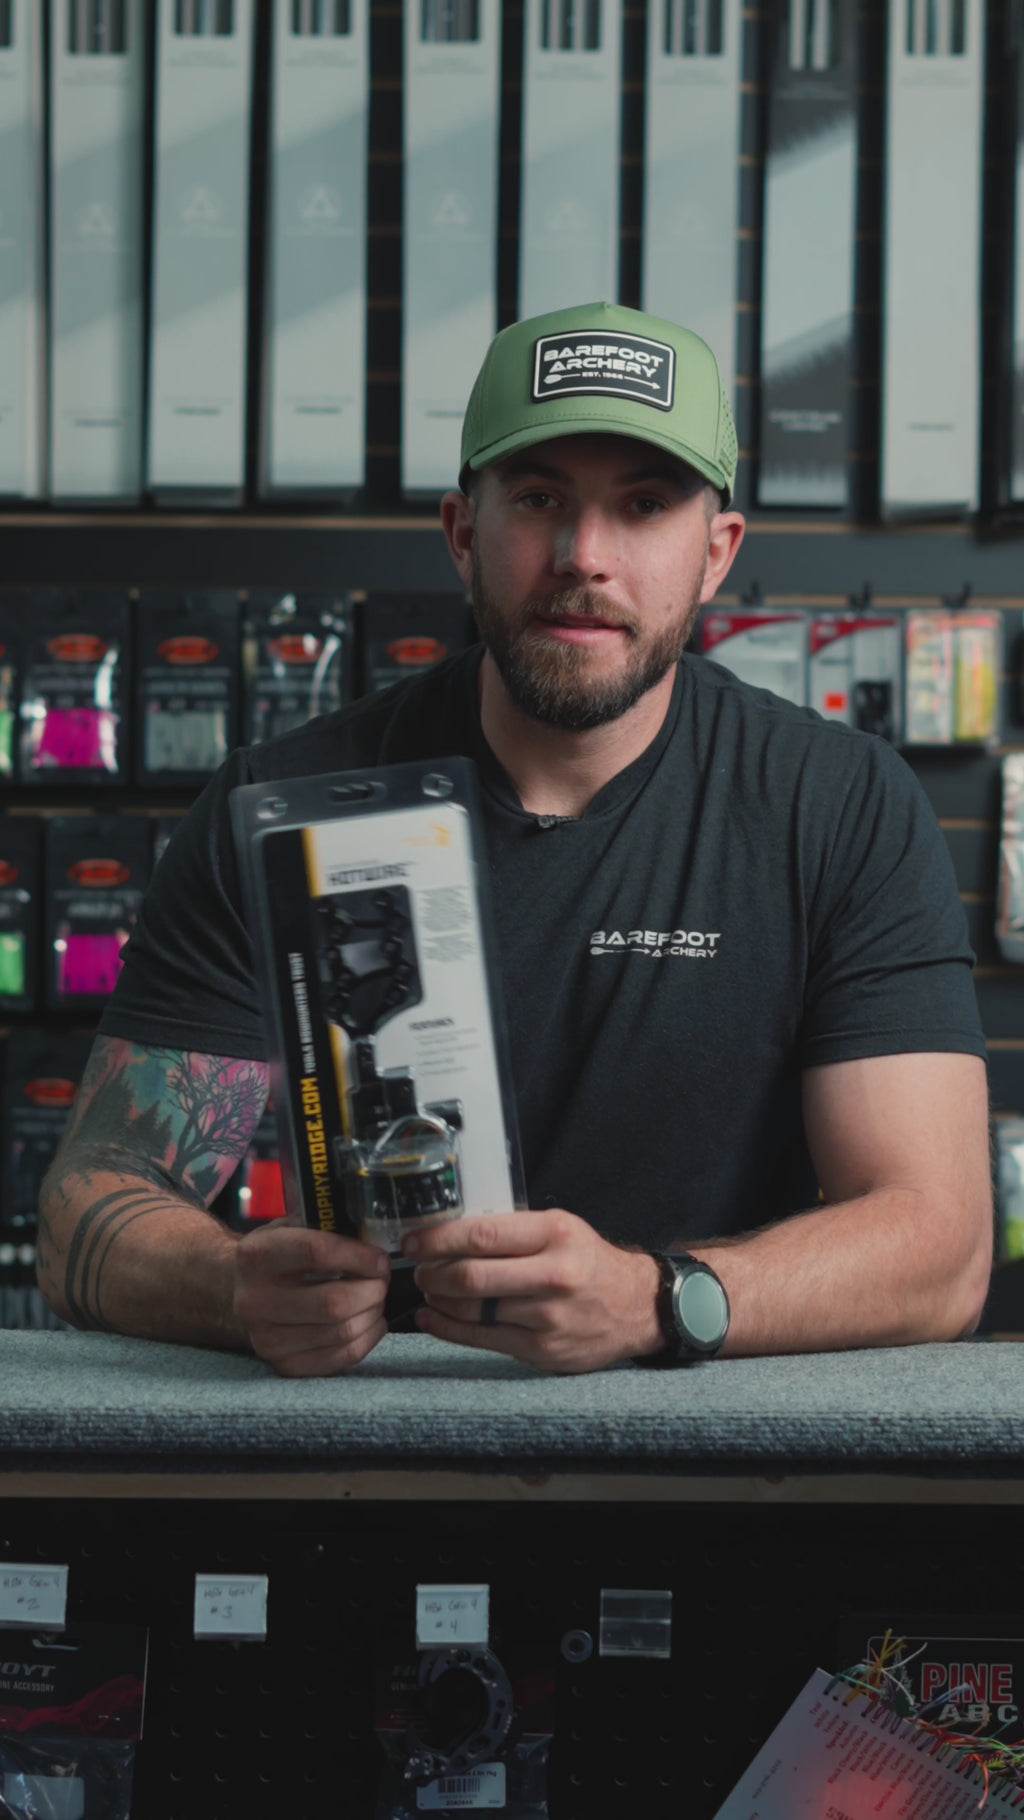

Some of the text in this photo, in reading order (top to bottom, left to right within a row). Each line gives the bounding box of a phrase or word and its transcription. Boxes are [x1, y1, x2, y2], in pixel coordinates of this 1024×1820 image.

[544, 345, 664, 367] BAREFOOT
[549, 357, 657, 378] ARCHERY
[590, 929, 721, 946] BAREFOOT
[651, 946, 717, 957] ARCHERY
[292, 982, 313, 1044] BOWHUNTERS
[301, 1044, 317, 1074] TOOLS
[300, 1077, 335, 1231] ROPHYRIDGE.COM
[0, 1661, 56, 1677] OYT
[920, 1662, 1013, 1704] PINE
